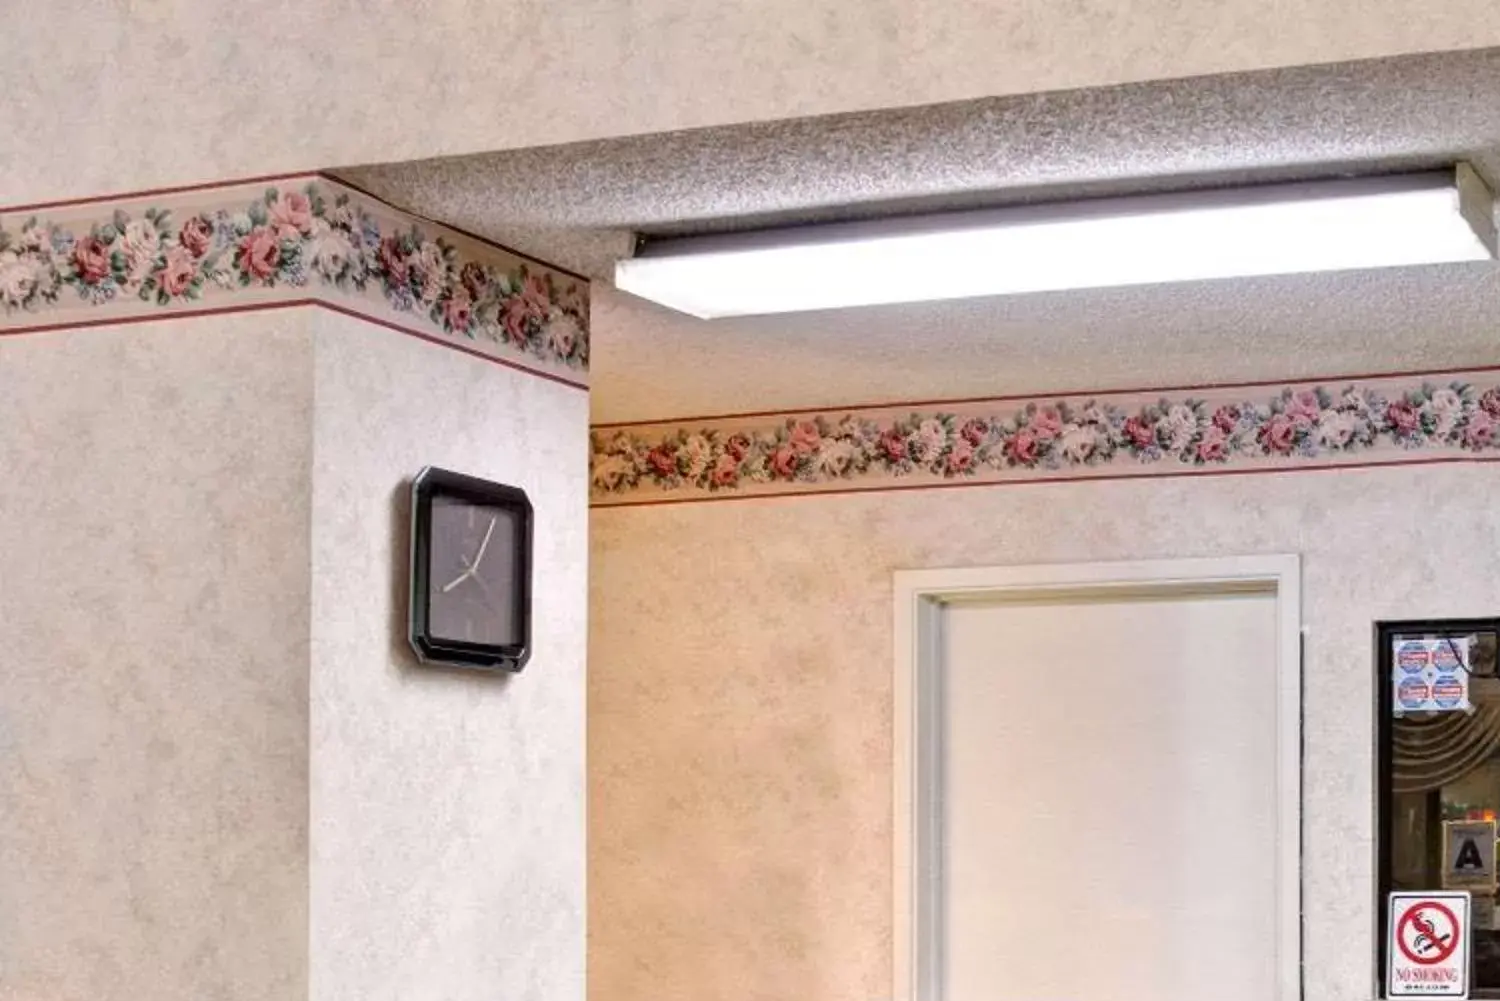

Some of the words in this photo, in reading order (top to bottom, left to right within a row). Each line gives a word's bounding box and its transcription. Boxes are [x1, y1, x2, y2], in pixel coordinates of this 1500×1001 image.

[1455, 838, 1483, 868] A
[1395, 967, 1411, 982] NO
[1412, 967, 1458, 982] SMOKING
